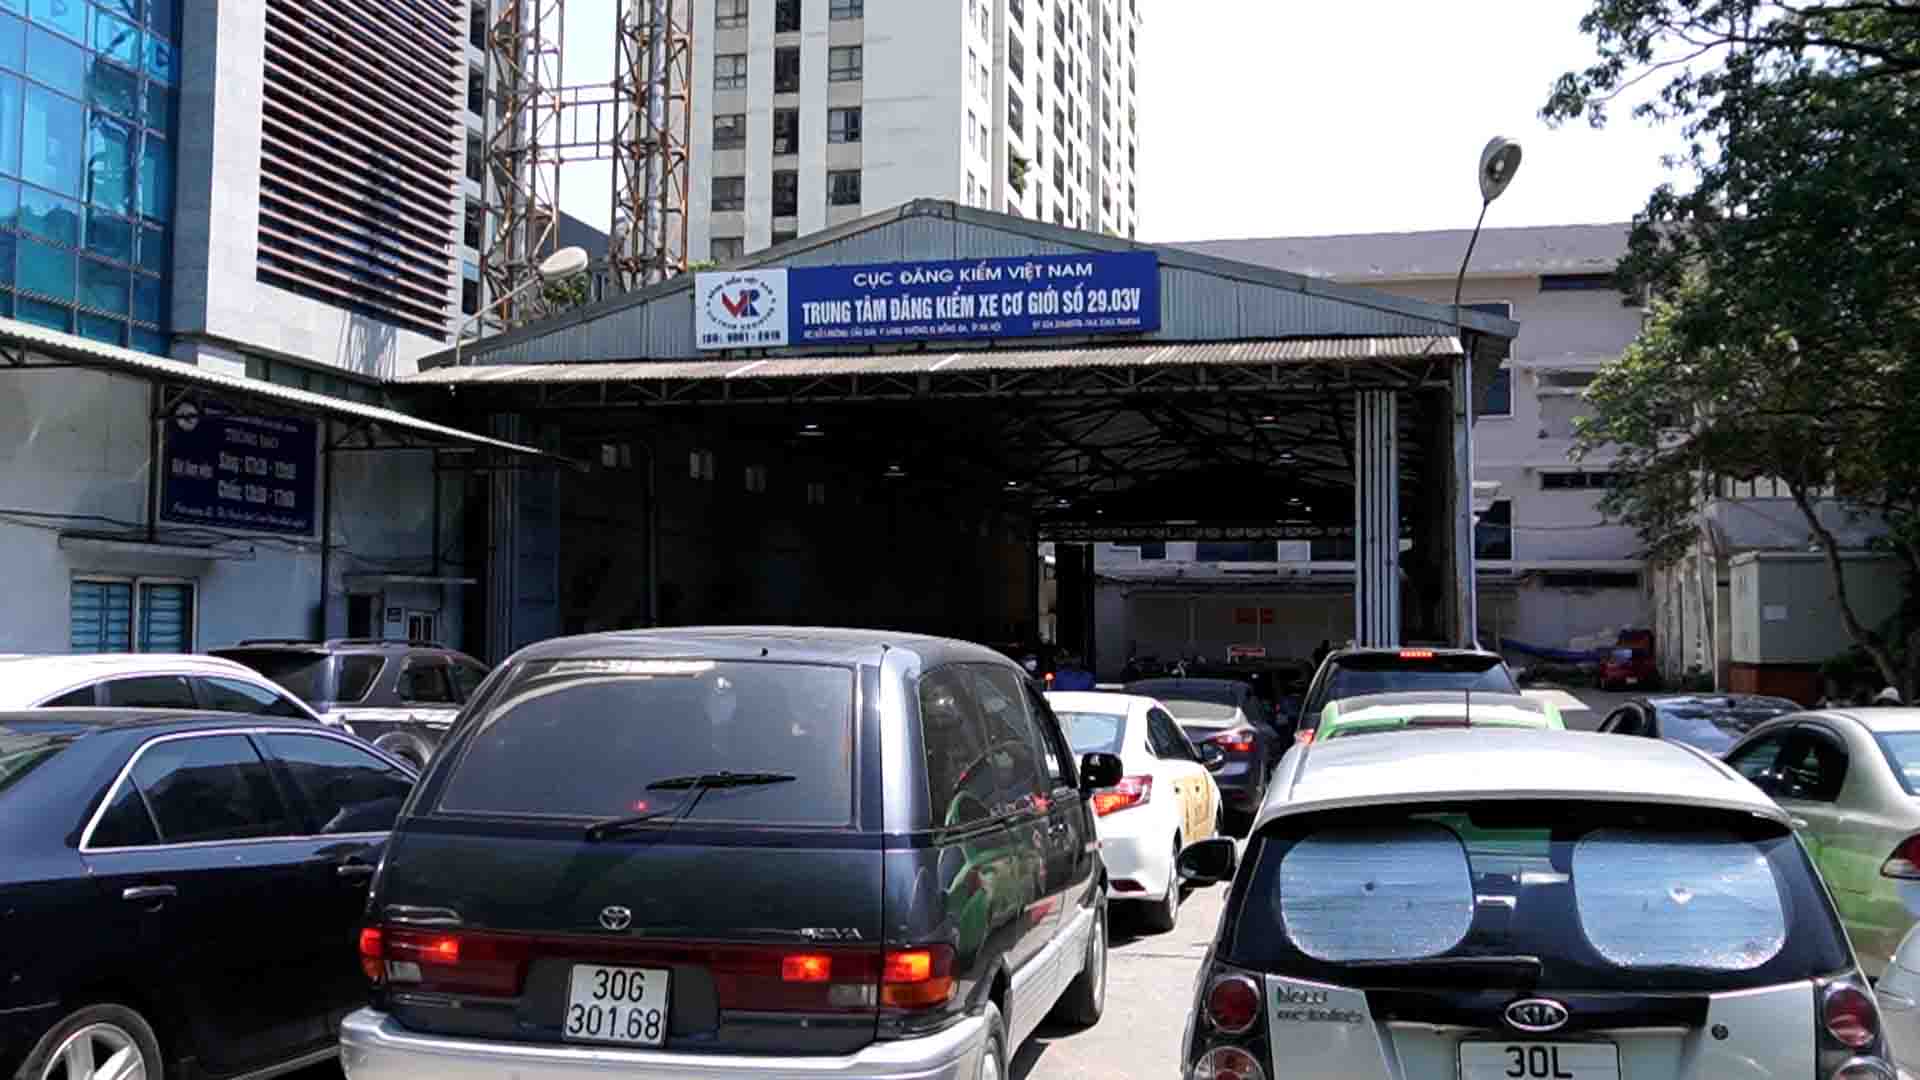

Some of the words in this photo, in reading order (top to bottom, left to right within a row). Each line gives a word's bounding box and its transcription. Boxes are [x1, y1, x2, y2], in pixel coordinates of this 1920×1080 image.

[853, 271, 893, 289] CỤC
[900, 267, 954, 285] ĐĂNG
[960, 259, 1002, 282] KIỂM
[1007, 261, 1043, 283] VIỆT
[1048, 263, 1093, 278] NAM
[802, 301, 851, 325] TRUNG
[855, 294, 887, 323] TÂM
[890, 292, 932, 321] ĐĂNG
[936, 284, 975, 320] KIỂM
[979, 293, 999, 318] XE
[1002, 289, 1024, 316] CƠ
[1028, 283, 1060, 315] GIỚI
[1063, 281, 1085, 314] SỐ
[1087, 287, 1141, 313] 29.03V
[593, 969, 645, 1002] 30G
[569, 1004, 661, 1040] 301.68
[1515, 1005, 1559, 1025] KIA
[1505, 1046, 1573, 1079] 30L
